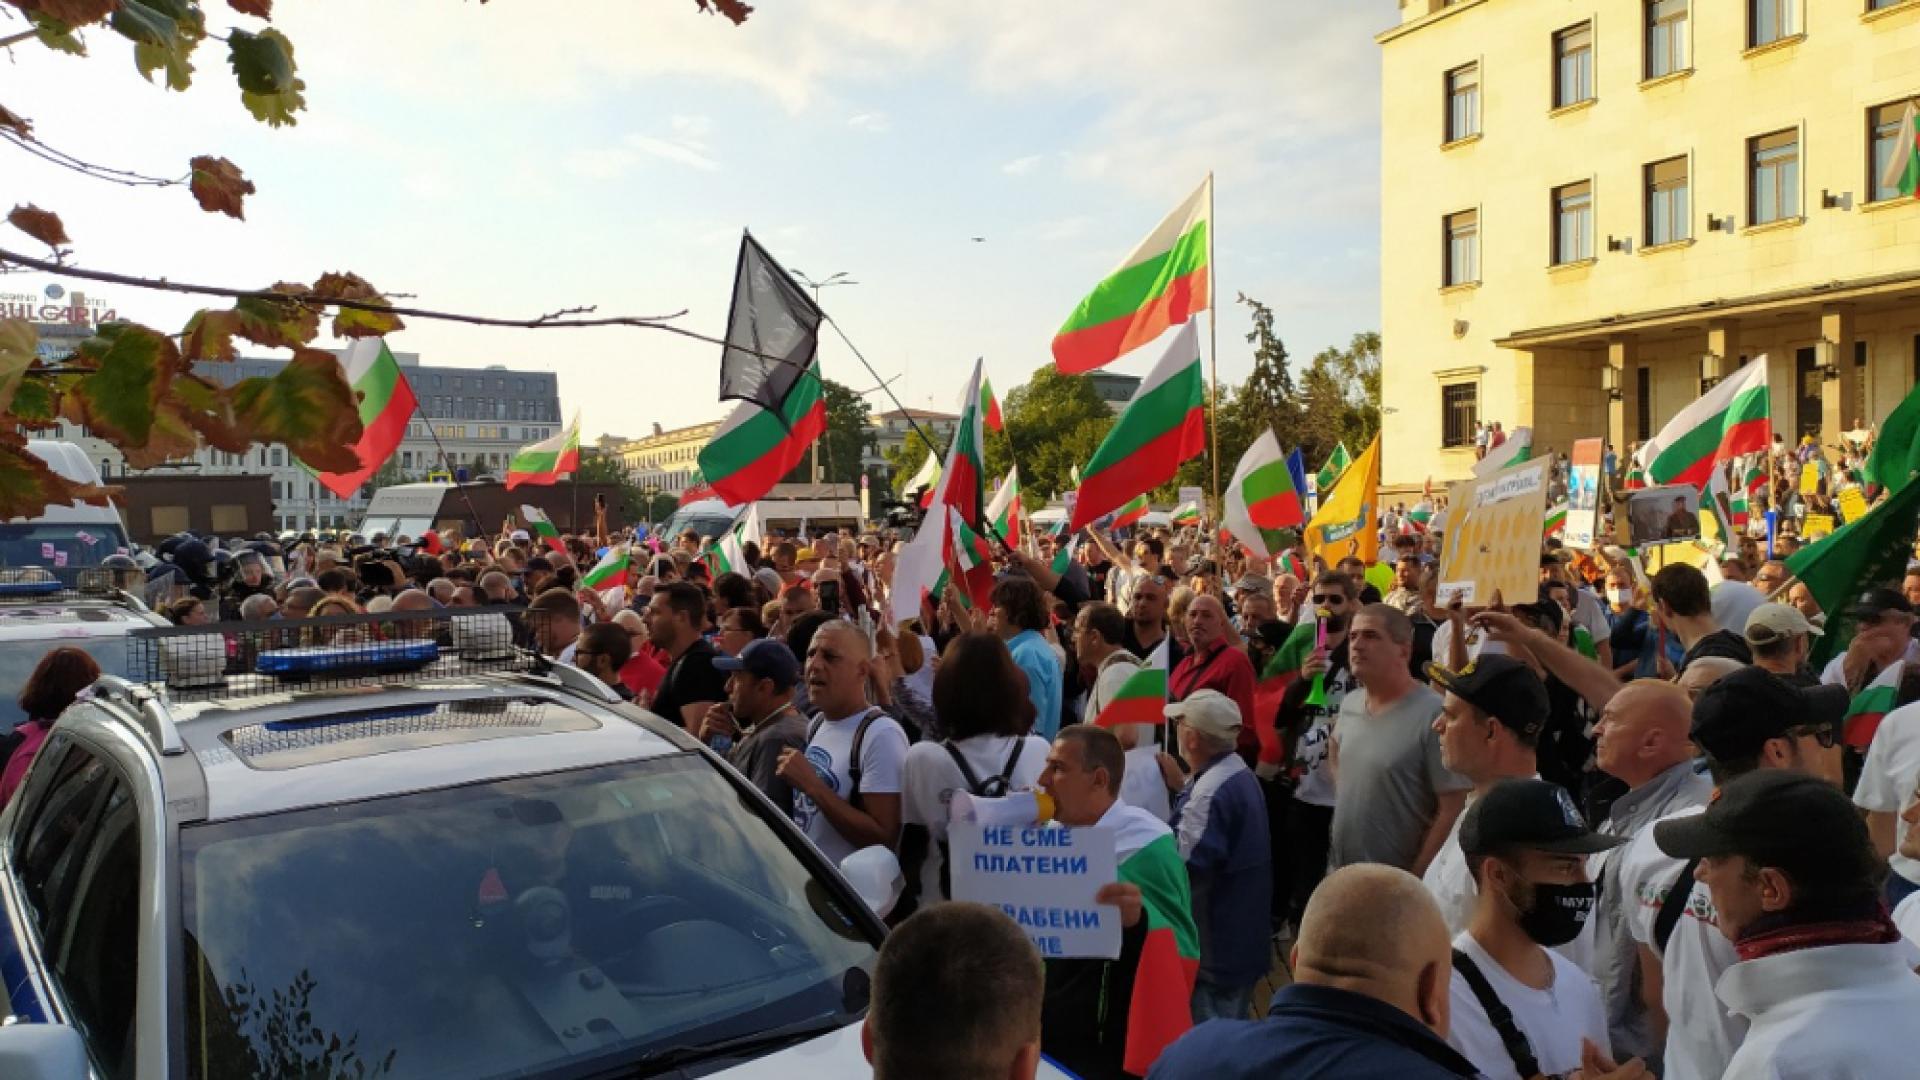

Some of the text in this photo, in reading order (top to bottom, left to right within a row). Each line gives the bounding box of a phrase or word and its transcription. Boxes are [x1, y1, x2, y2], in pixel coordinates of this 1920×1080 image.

[983, 826, 1072, 847] НЕ СМЕ
[975, 853, 1087, 874] ПЛАТЕНИ
[993, 904, 1099, 928] РАБЕНИ
